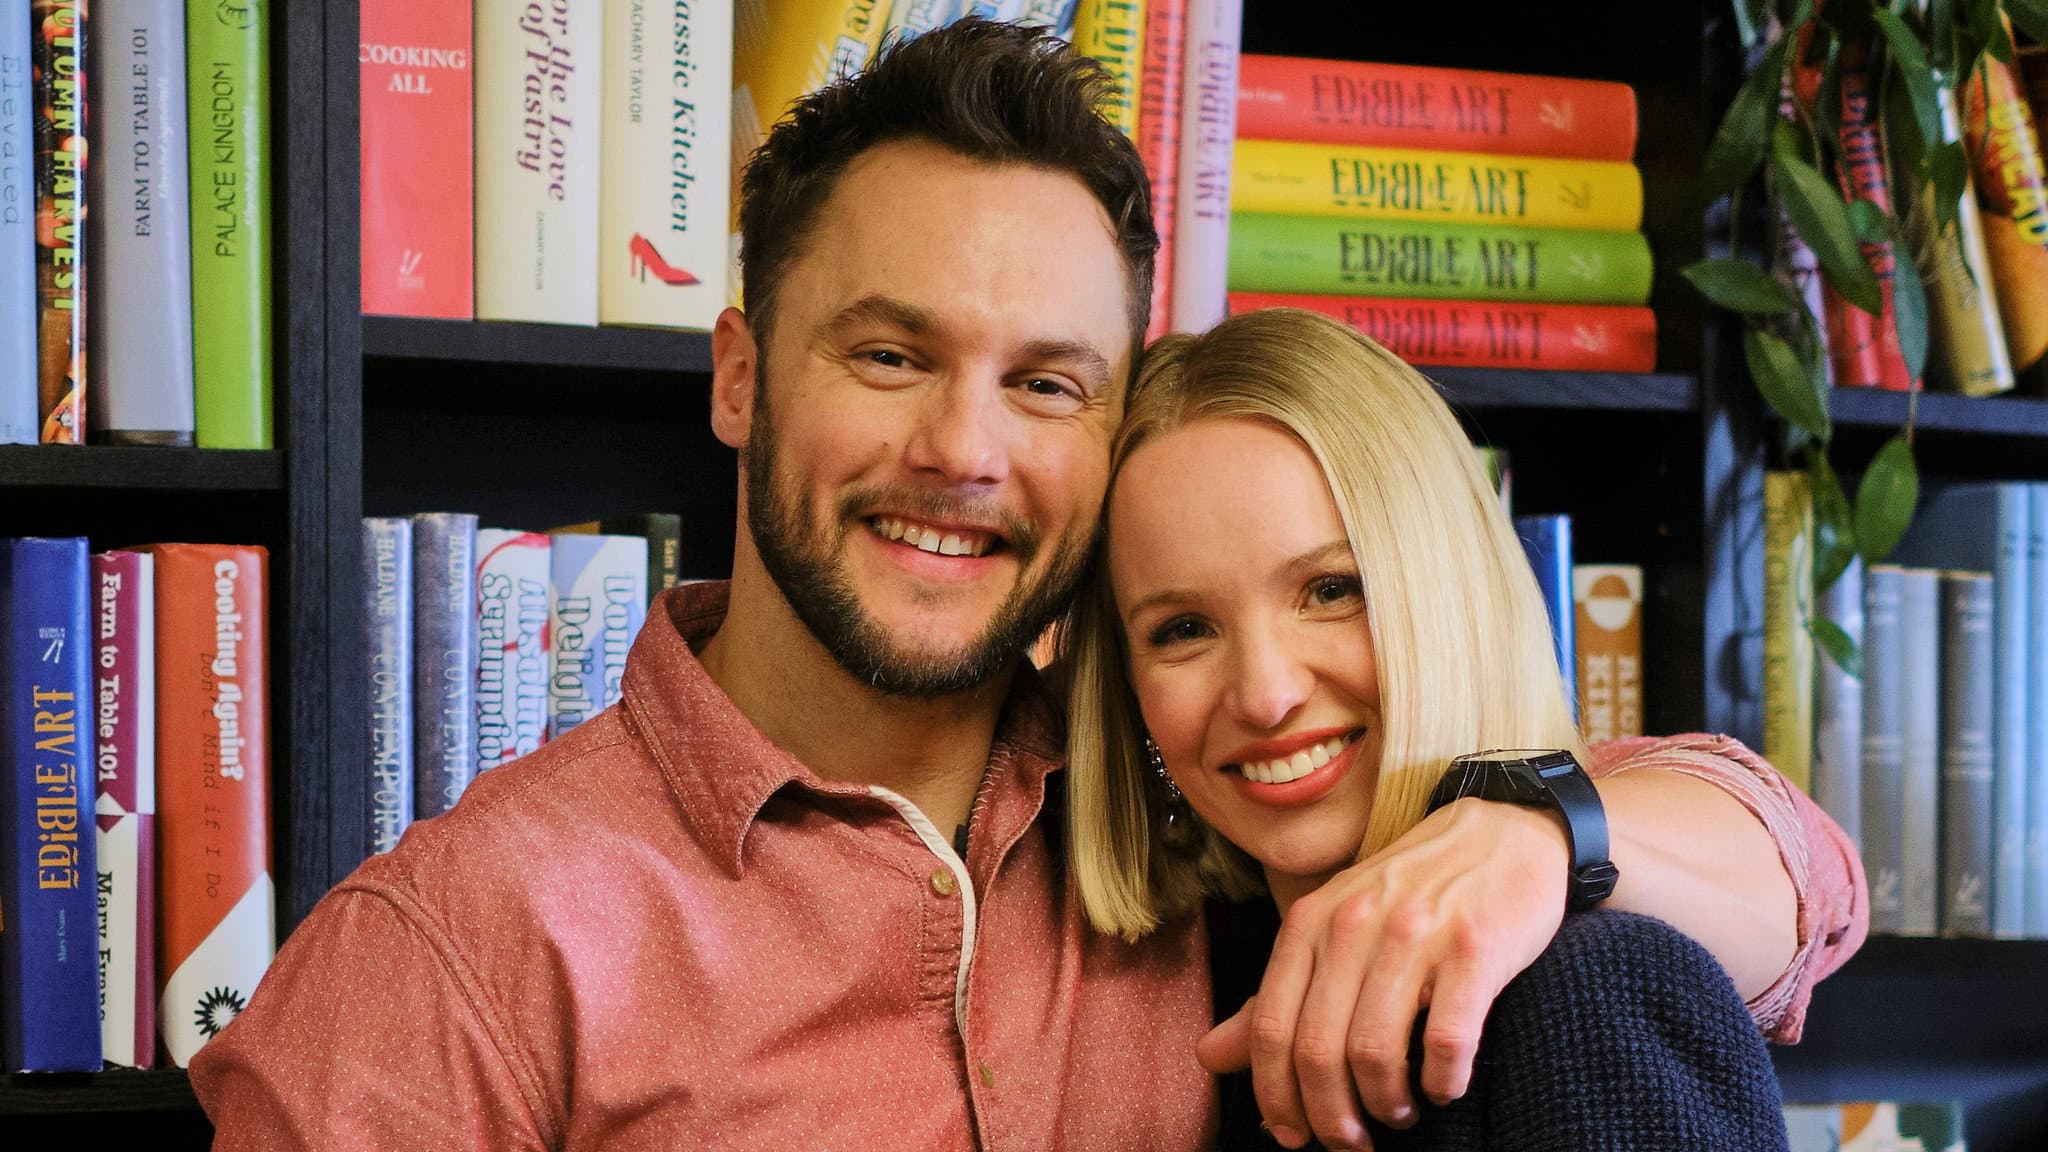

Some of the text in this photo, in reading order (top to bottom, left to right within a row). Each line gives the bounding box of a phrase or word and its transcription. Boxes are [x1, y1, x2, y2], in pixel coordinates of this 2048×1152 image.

[359, 43, 467, 70] COOKING
[387, 73, 432, 95] ALL
[517, 3, 551, 174] of Pastry
[550, 46, 575, 103] the
[629, 0, 643, 124] ACHARY TAYLOR
[2, 55, 23, 224] Elevated
[132, 28, 151, 238] FARM TO TABLE 101
[1448, 85, 1513, 135] ART
[211, 62, 237, 258] PALACE KINGDOM
[549, 115, 573, 201] Love
[671, 98, 697, 233] Kitchen
[1459, 165, 1533, 217] ART
[53, 150, 80, 311] HARVEST
[1477, 237, 1541, 291] ART
[1483, 310, 1545, 361] ART
[376, 538, 396, 616] HALDANE
[449, 535, 468, 613] HALDANE
[98, 572, 121, 782] Farm to Table 101
[212, 558, 246, 781] Cooking Again?
[33, 684, 77, 756] ART
[199, 652, 221, 899] Don't Mind if I Do
[97, 870, 113, 942] Mary
